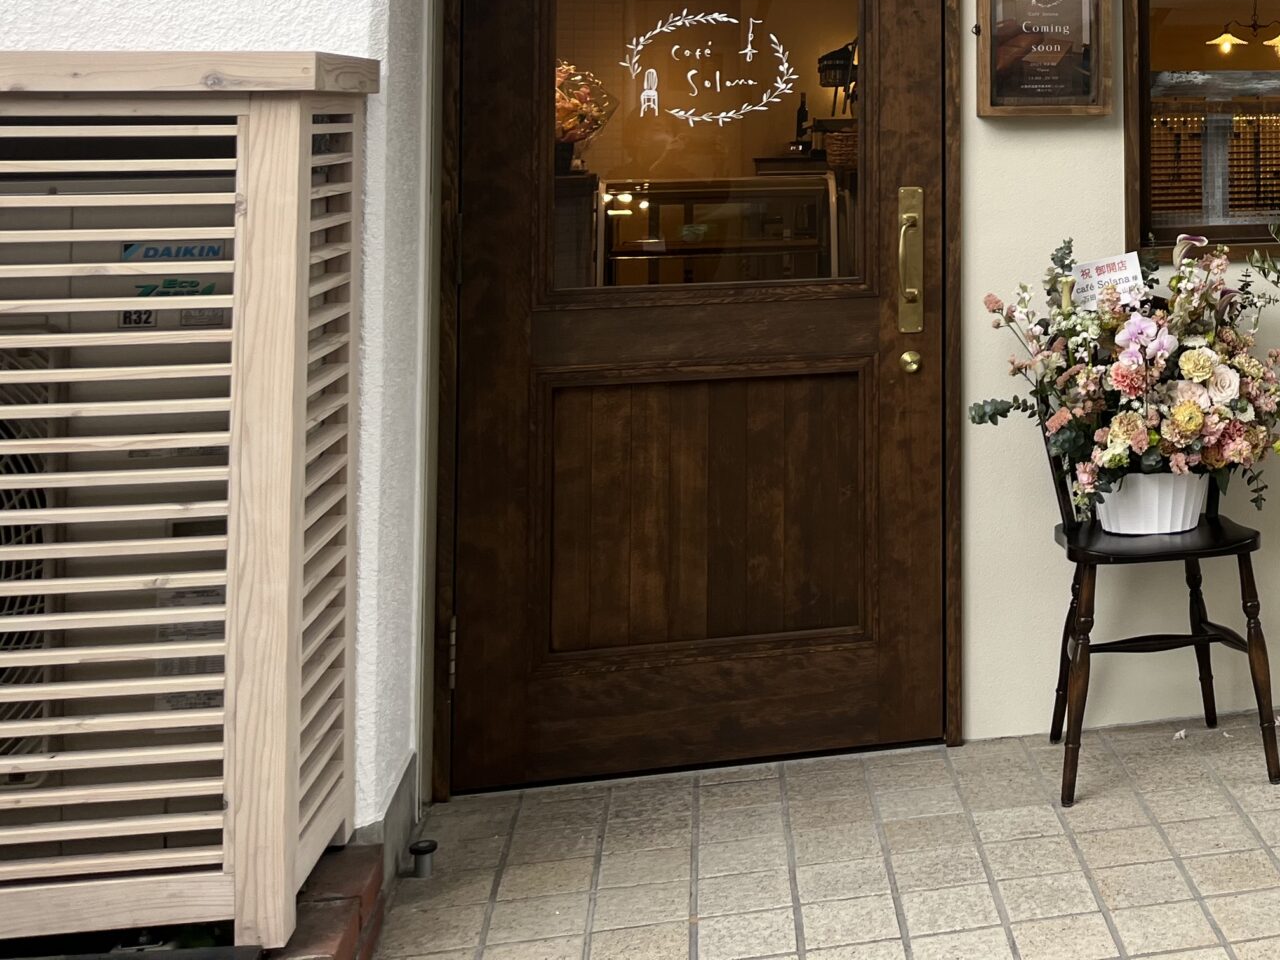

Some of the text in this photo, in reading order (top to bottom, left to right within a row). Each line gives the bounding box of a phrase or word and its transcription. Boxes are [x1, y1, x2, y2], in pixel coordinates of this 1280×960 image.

[1022, 21, 1070, 35] Coming
[671, 40, 713, 61] Café
[1031, 44, 1061, 52] soon
[143, 244, 221, 259] DAIKIN
[1076, 282, 1095, 294] café
[1097, 276, 1130, 289] Solana
[122, 309, 153, 325] R32
